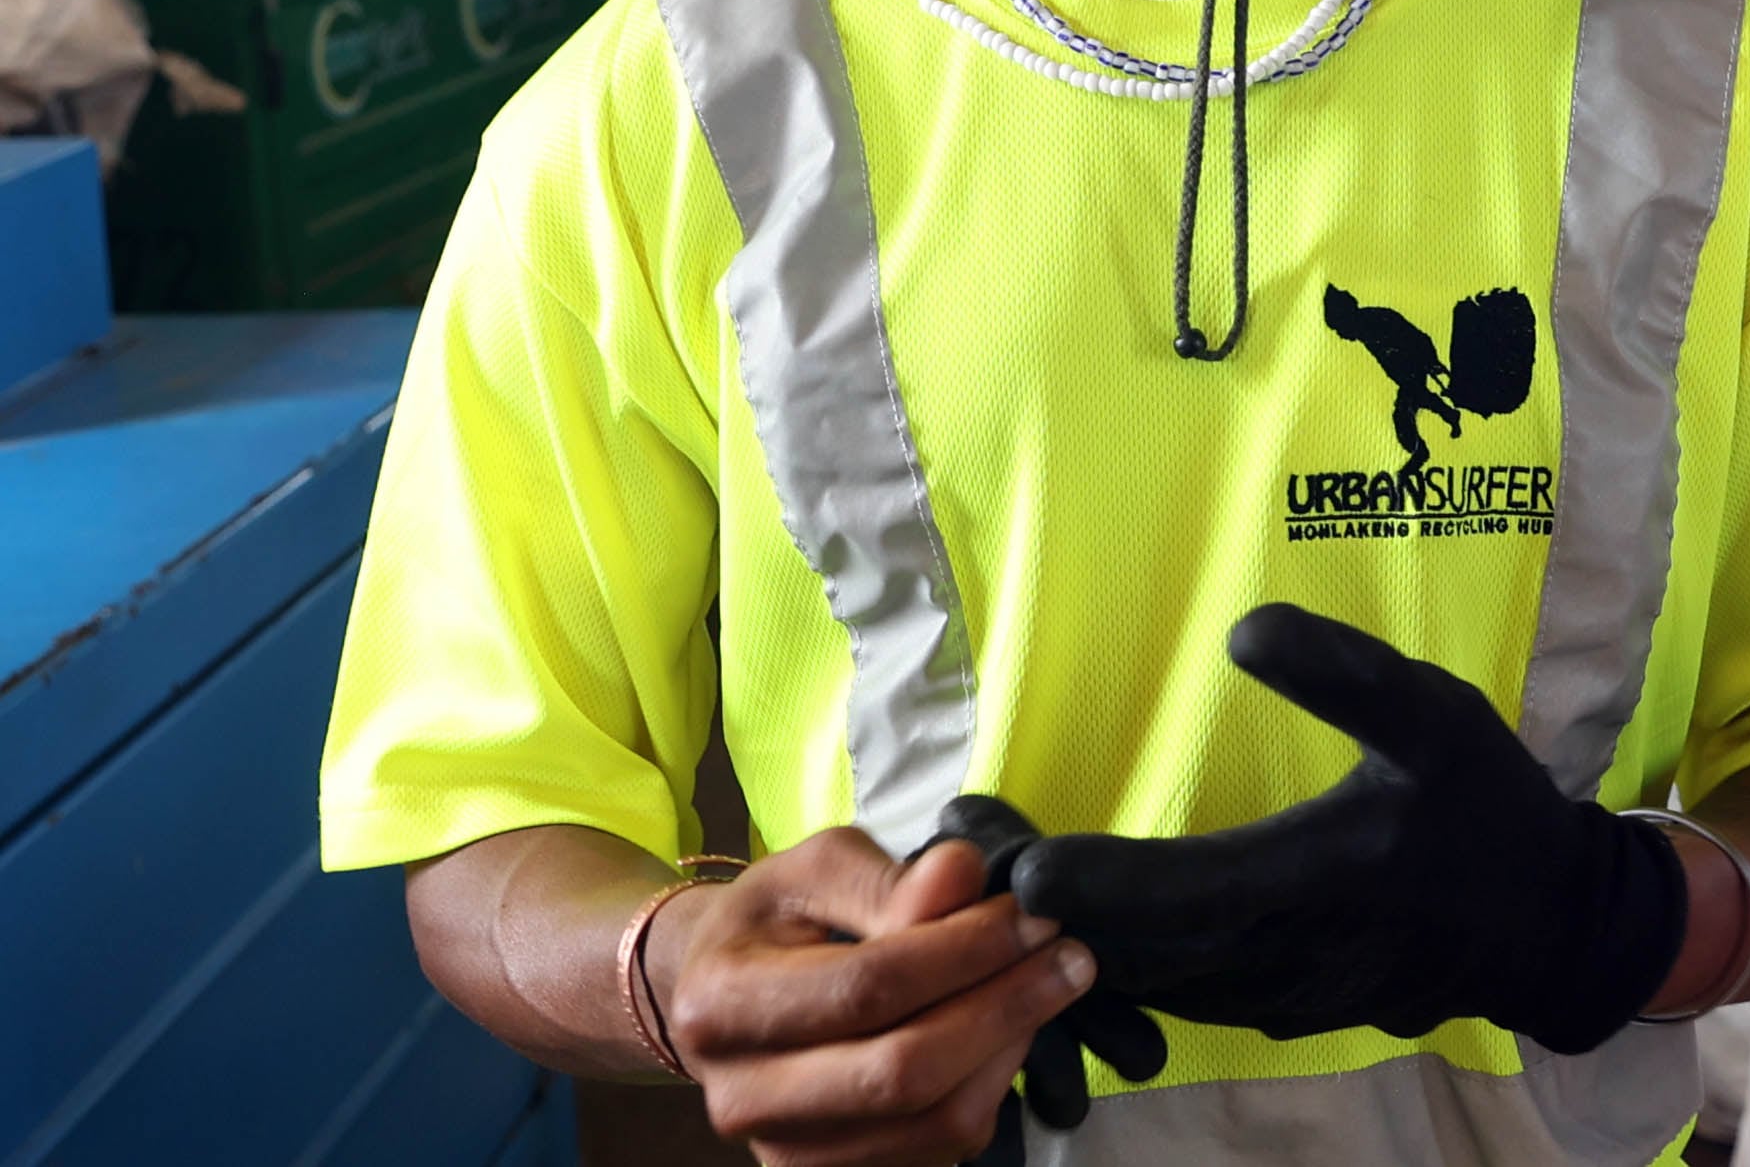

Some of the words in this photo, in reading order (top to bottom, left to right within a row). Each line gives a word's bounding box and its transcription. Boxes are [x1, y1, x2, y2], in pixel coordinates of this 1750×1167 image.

[1287, 521, 1410, 542] MOHLAKENG
[1420, 517, 1509, 538] RECYCLING
[1518, 518, 1554, 536] HUB
